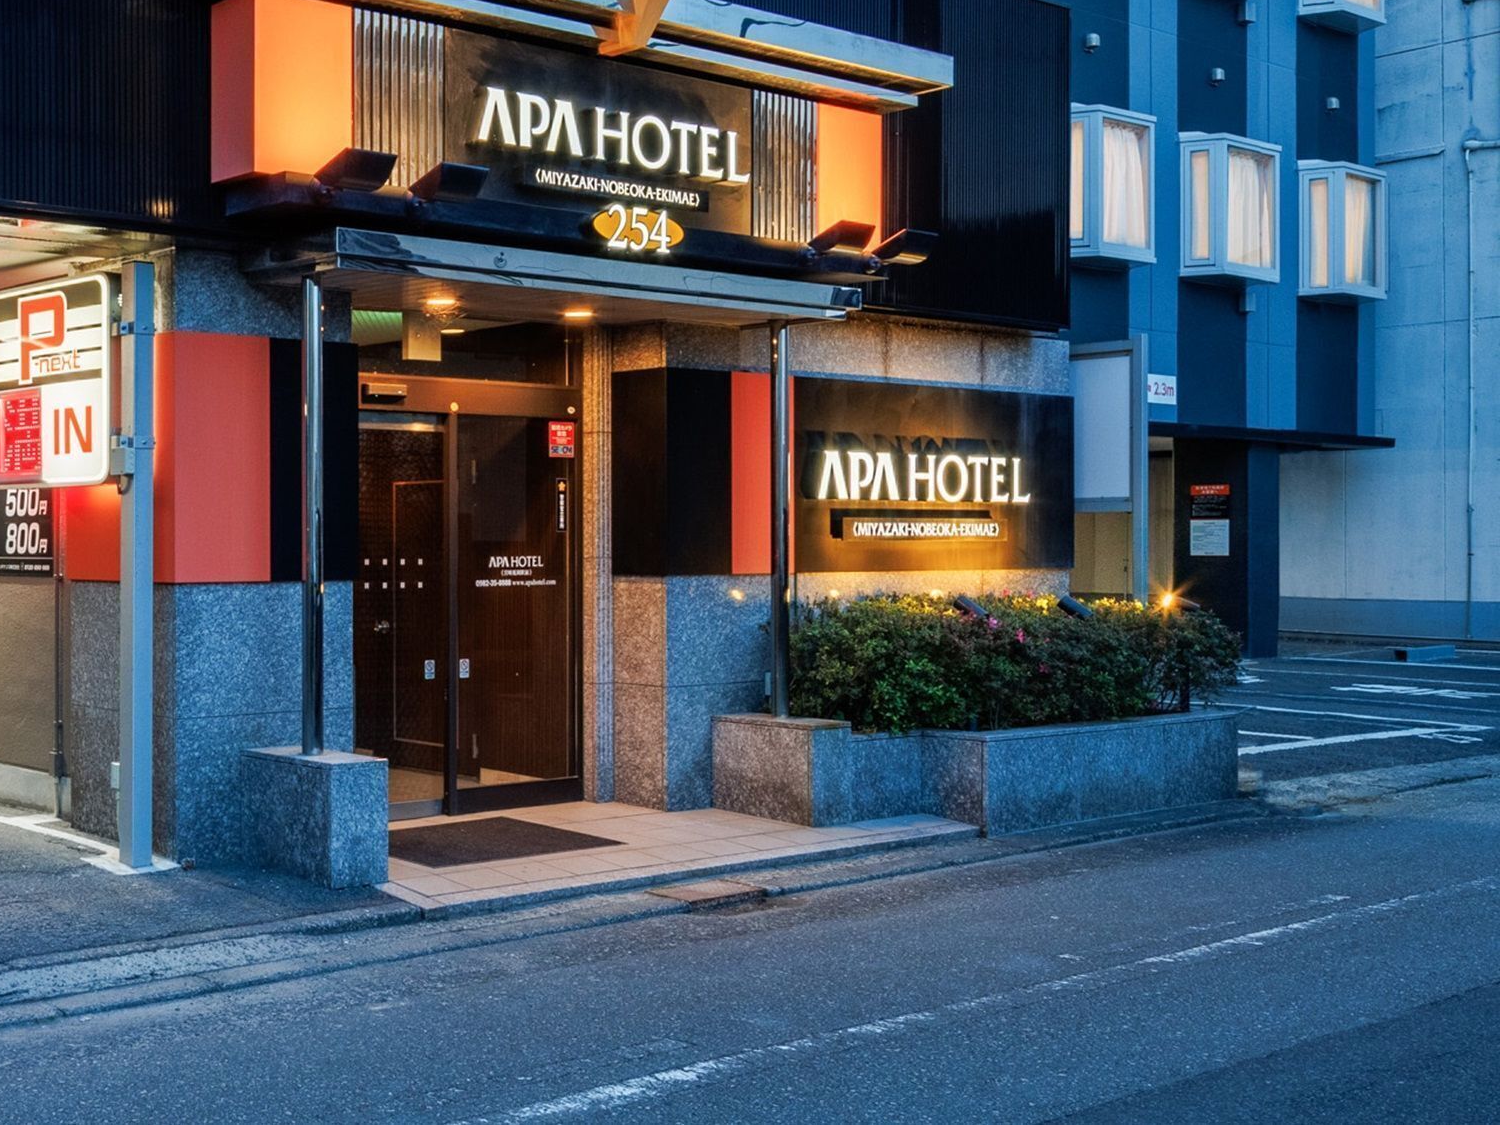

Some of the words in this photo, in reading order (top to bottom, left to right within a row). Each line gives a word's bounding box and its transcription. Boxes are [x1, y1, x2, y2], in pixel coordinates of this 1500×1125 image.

[477, 86, 584, 157] APA
[593, 106, 751, 184] HOTEL
[606, 204, 671, 253] 254
[1153, 381, 1175, 397] 2.3m
[53, 405, 93, 456] IN
[817, 450, 900, 500] APA
[908, 453, 1032, 503] HOTEL
[5, 488, 47, 517] 500円
[5, 522, 48, 554] 800円
[488, 556, 510, 568] APA
[510, 555, 544, 568] HOTEL
